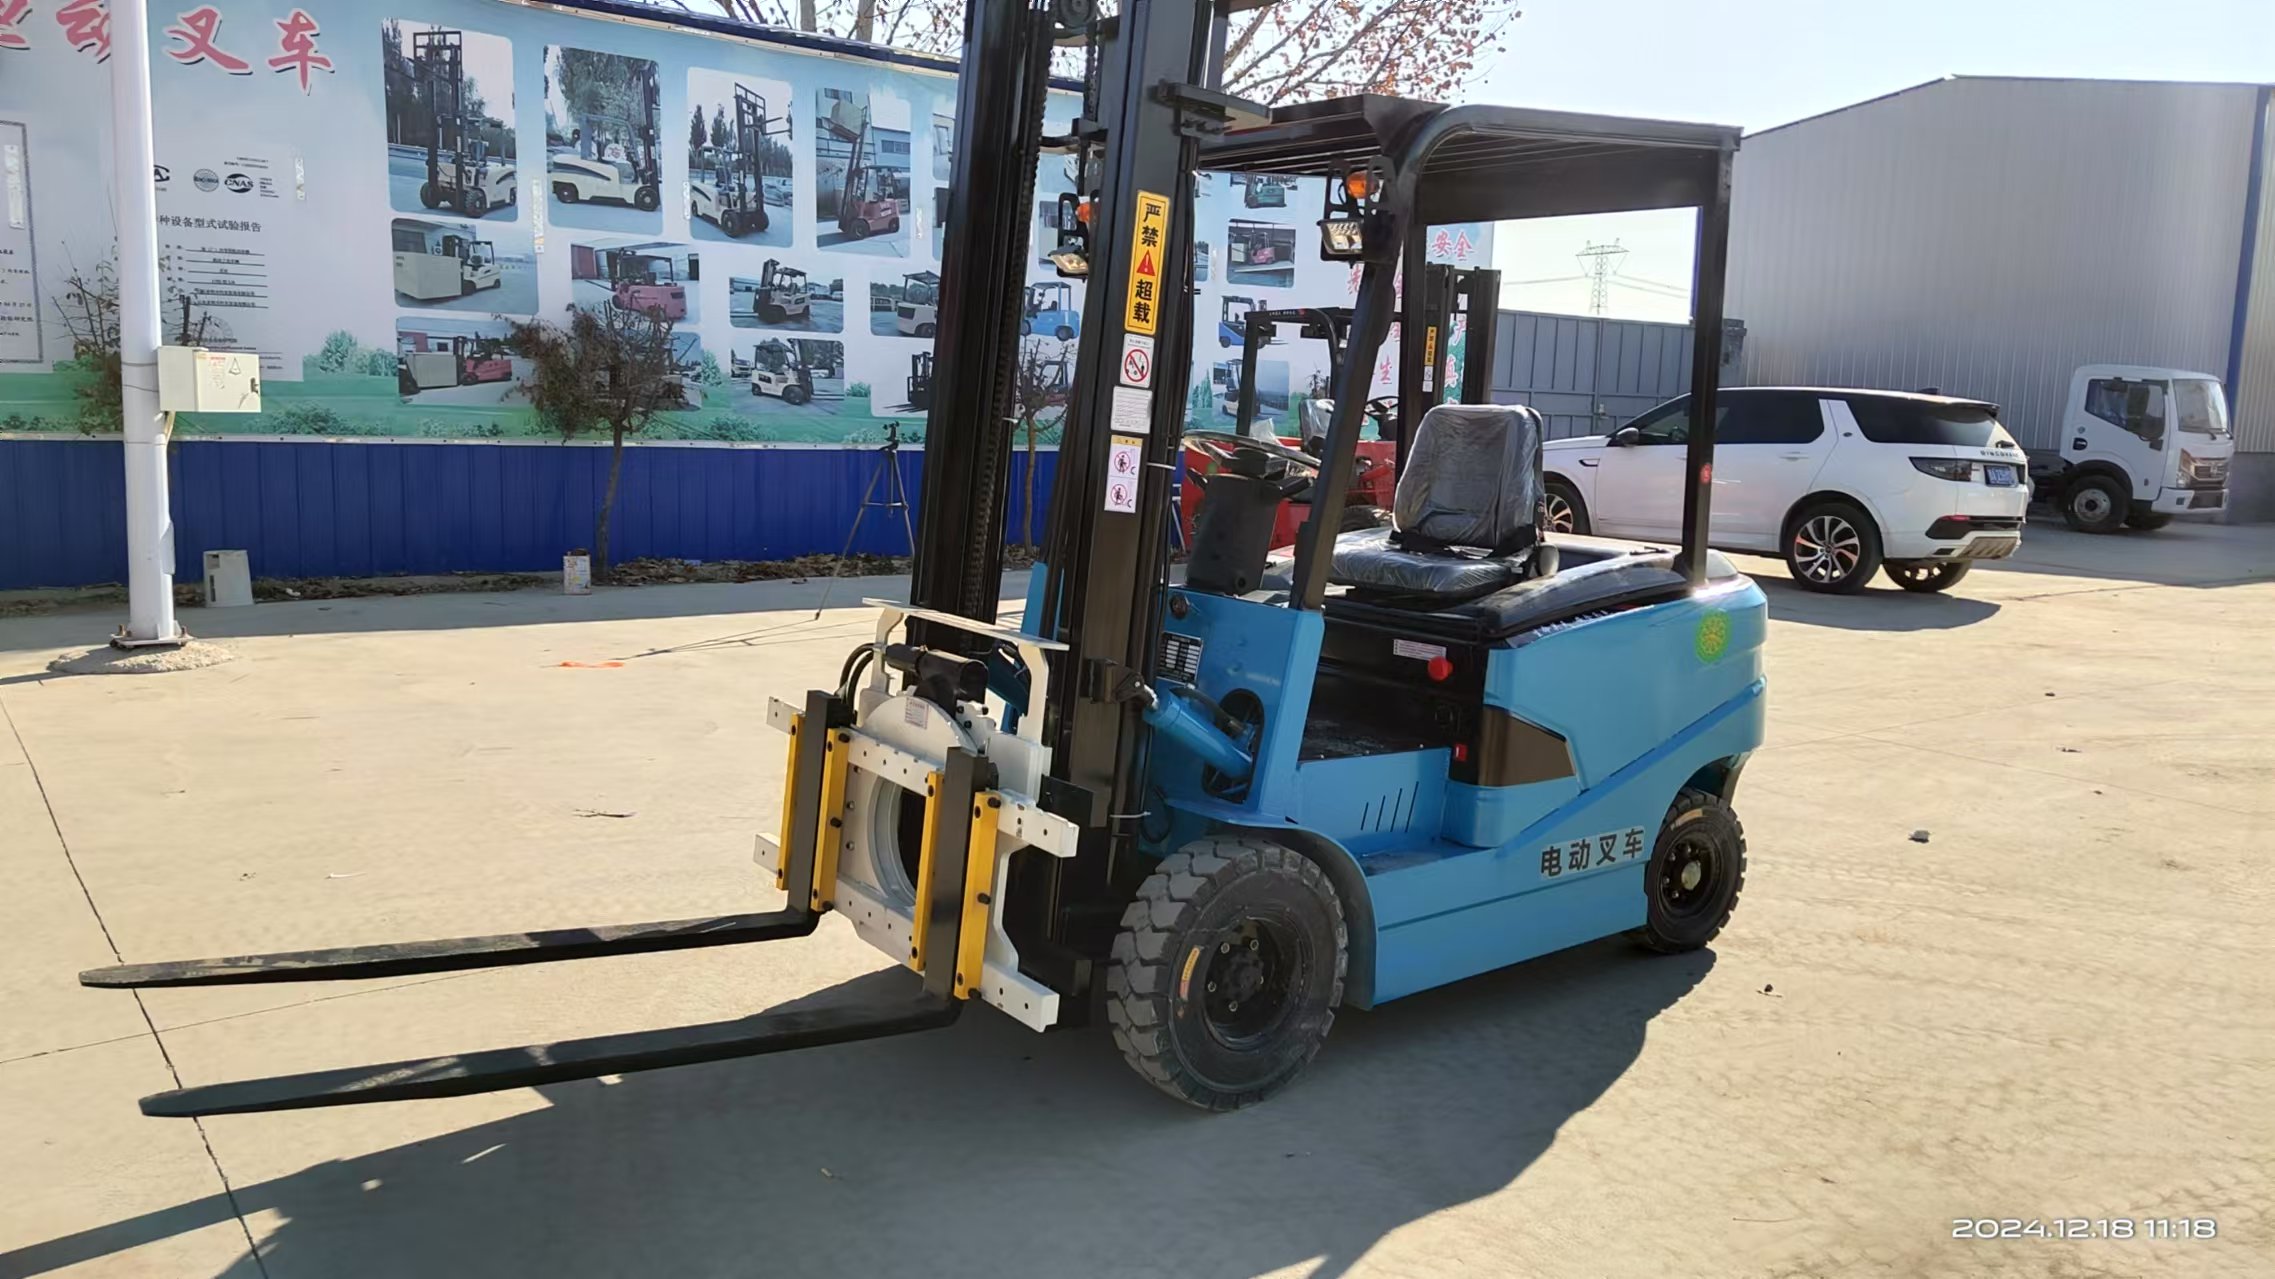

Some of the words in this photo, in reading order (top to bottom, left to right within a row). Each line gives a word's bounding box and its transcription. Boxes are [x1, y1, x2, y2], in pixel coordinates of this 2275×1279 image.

[224, 179, 254, 188] CNAS
[1132, 203, 1161, 324] 严禁超载
[1541, 828, 1644, 877] 电动叉车
